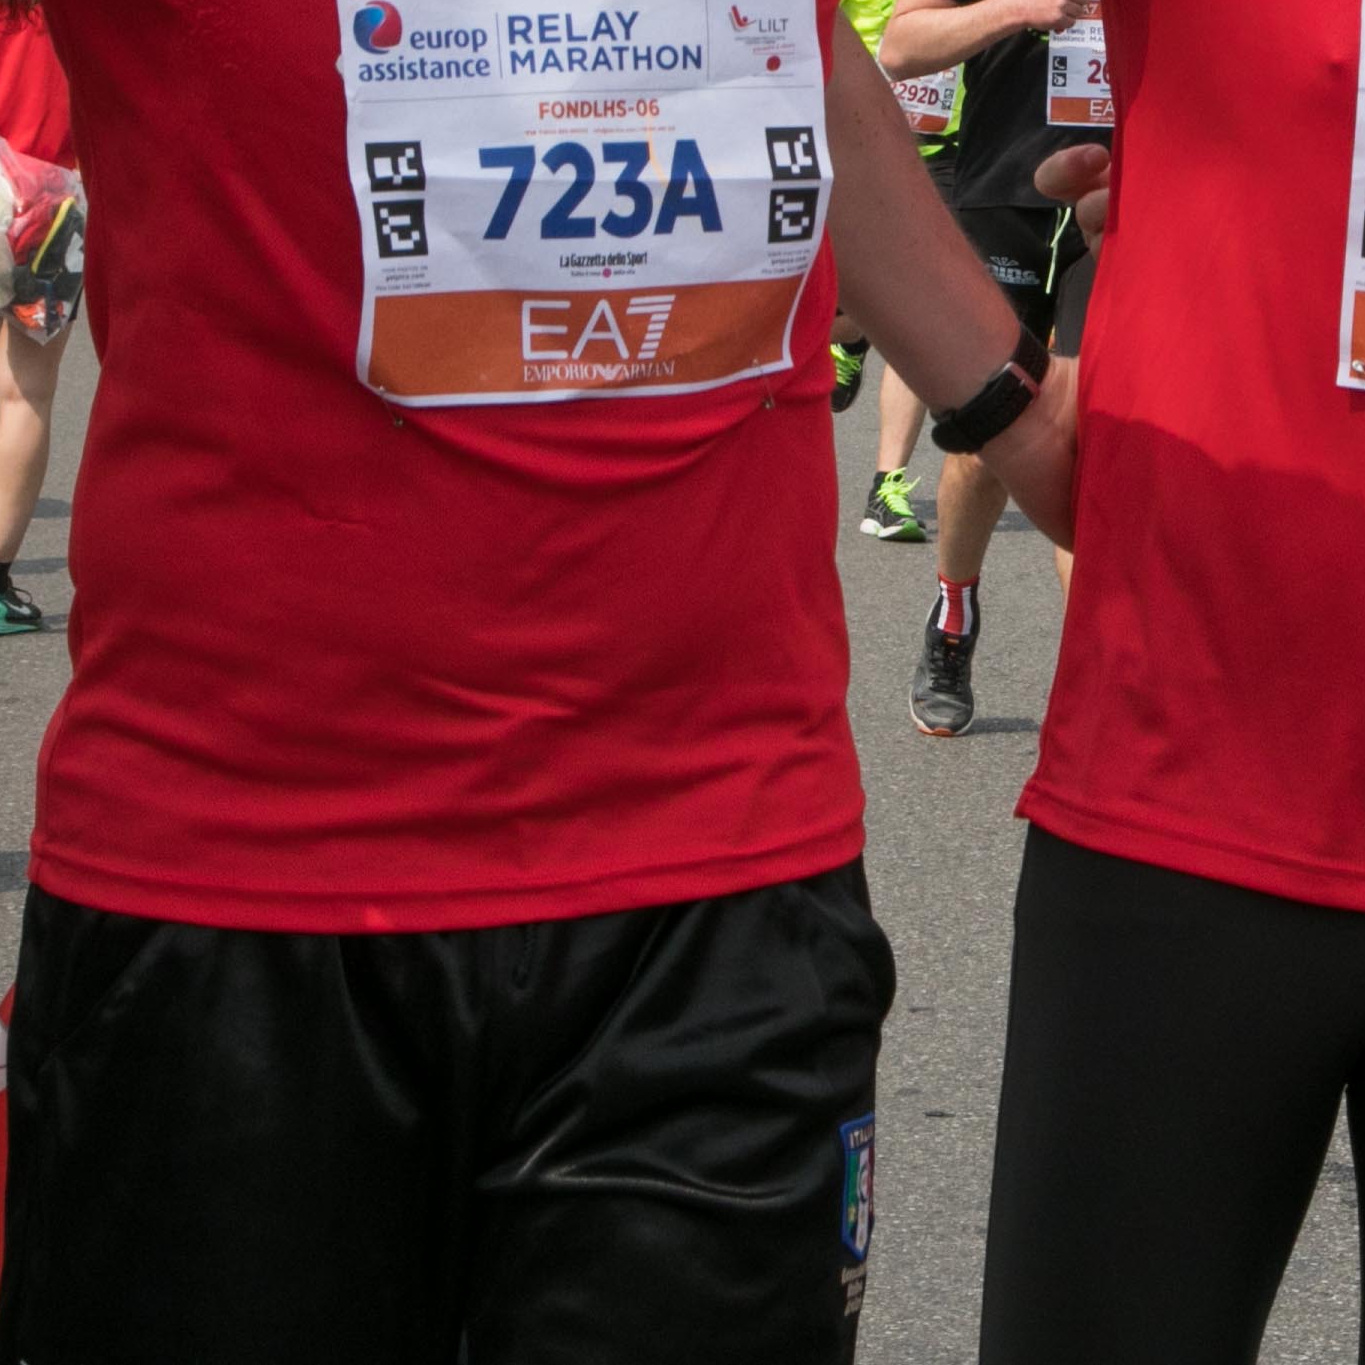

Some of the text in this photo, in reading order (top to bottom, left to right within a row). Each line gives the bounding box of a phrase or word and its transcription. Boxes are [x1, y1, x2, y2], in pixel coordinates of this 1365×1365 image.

[507, 11, 639, 47] RELAY
[758, 18, 788, 33] LILT
[410, 27, 487, 54] europ
[358, 54, 491, 81] assistance
[510, 44, 702, 74] MARATHON
[893, 82, 940, 105] 292D
[539, 99, 660, 120] FONDLHS-06
[1090, 99, 1115, 116] EA
[478, 139, 723, 240] 723A
[522, 294, 676, 360] EA7
[523, 360, 675, 382] EMPORIO ARMANI
